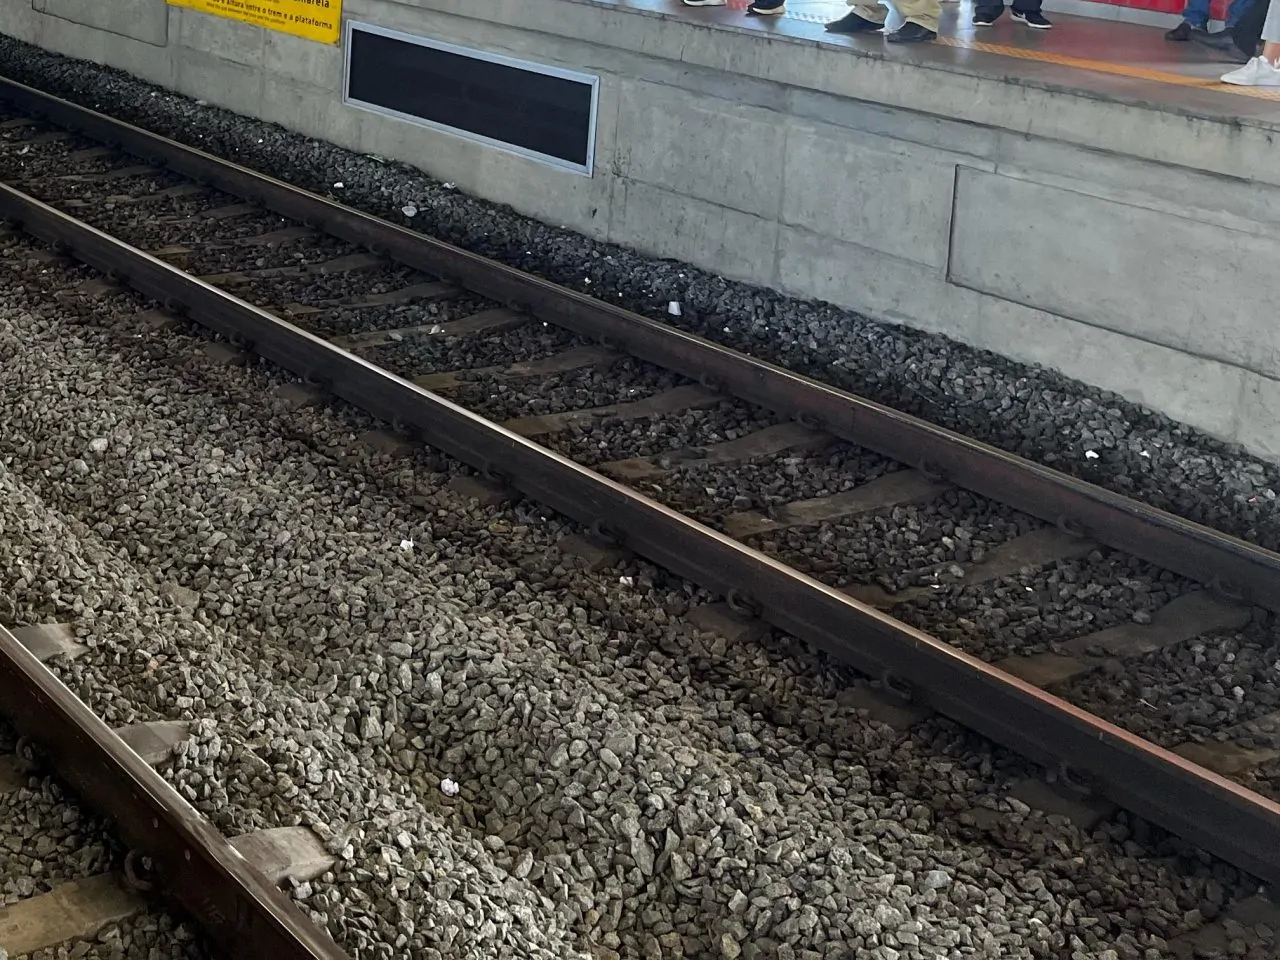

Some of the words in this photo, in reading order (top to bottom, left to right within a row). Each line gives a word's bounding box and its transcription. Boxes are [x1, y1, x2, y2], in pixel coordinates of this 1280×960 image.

[245, 3, 261, 14] entre
[268, 7, 282, 17] trem
[295, 15, 332, 29] plataforma
